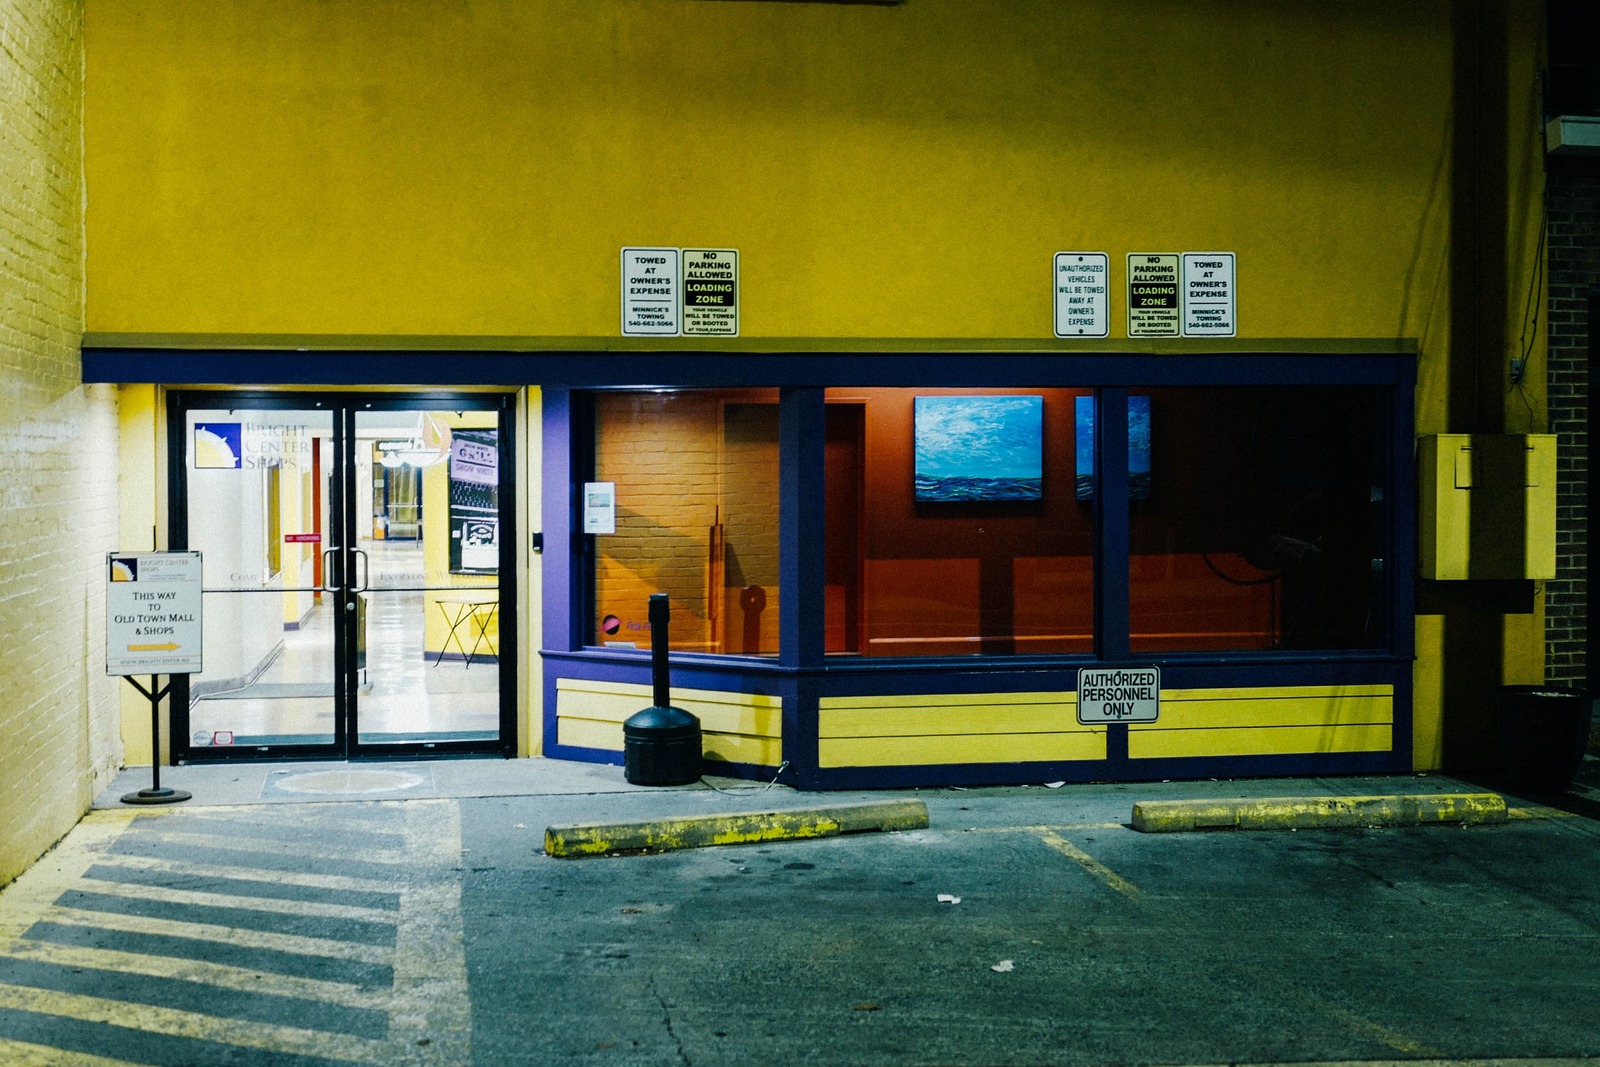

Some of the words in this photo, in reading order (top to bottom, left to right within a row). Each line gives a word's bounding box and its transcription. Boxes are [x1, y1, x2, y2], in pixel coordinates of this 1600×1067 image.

[246, 441, 310, 453] CENTER
[114, 615, 134, 623] OLD
[137, 614, 166, 623] TOWN
[169, 614, 195, 622] MALL
[1084, 673, 1154, 687] AUTHORIZED
[1083, 688, 1154, 701] PERSONNEL
[1103, 702, 1134, 715] ONLY
